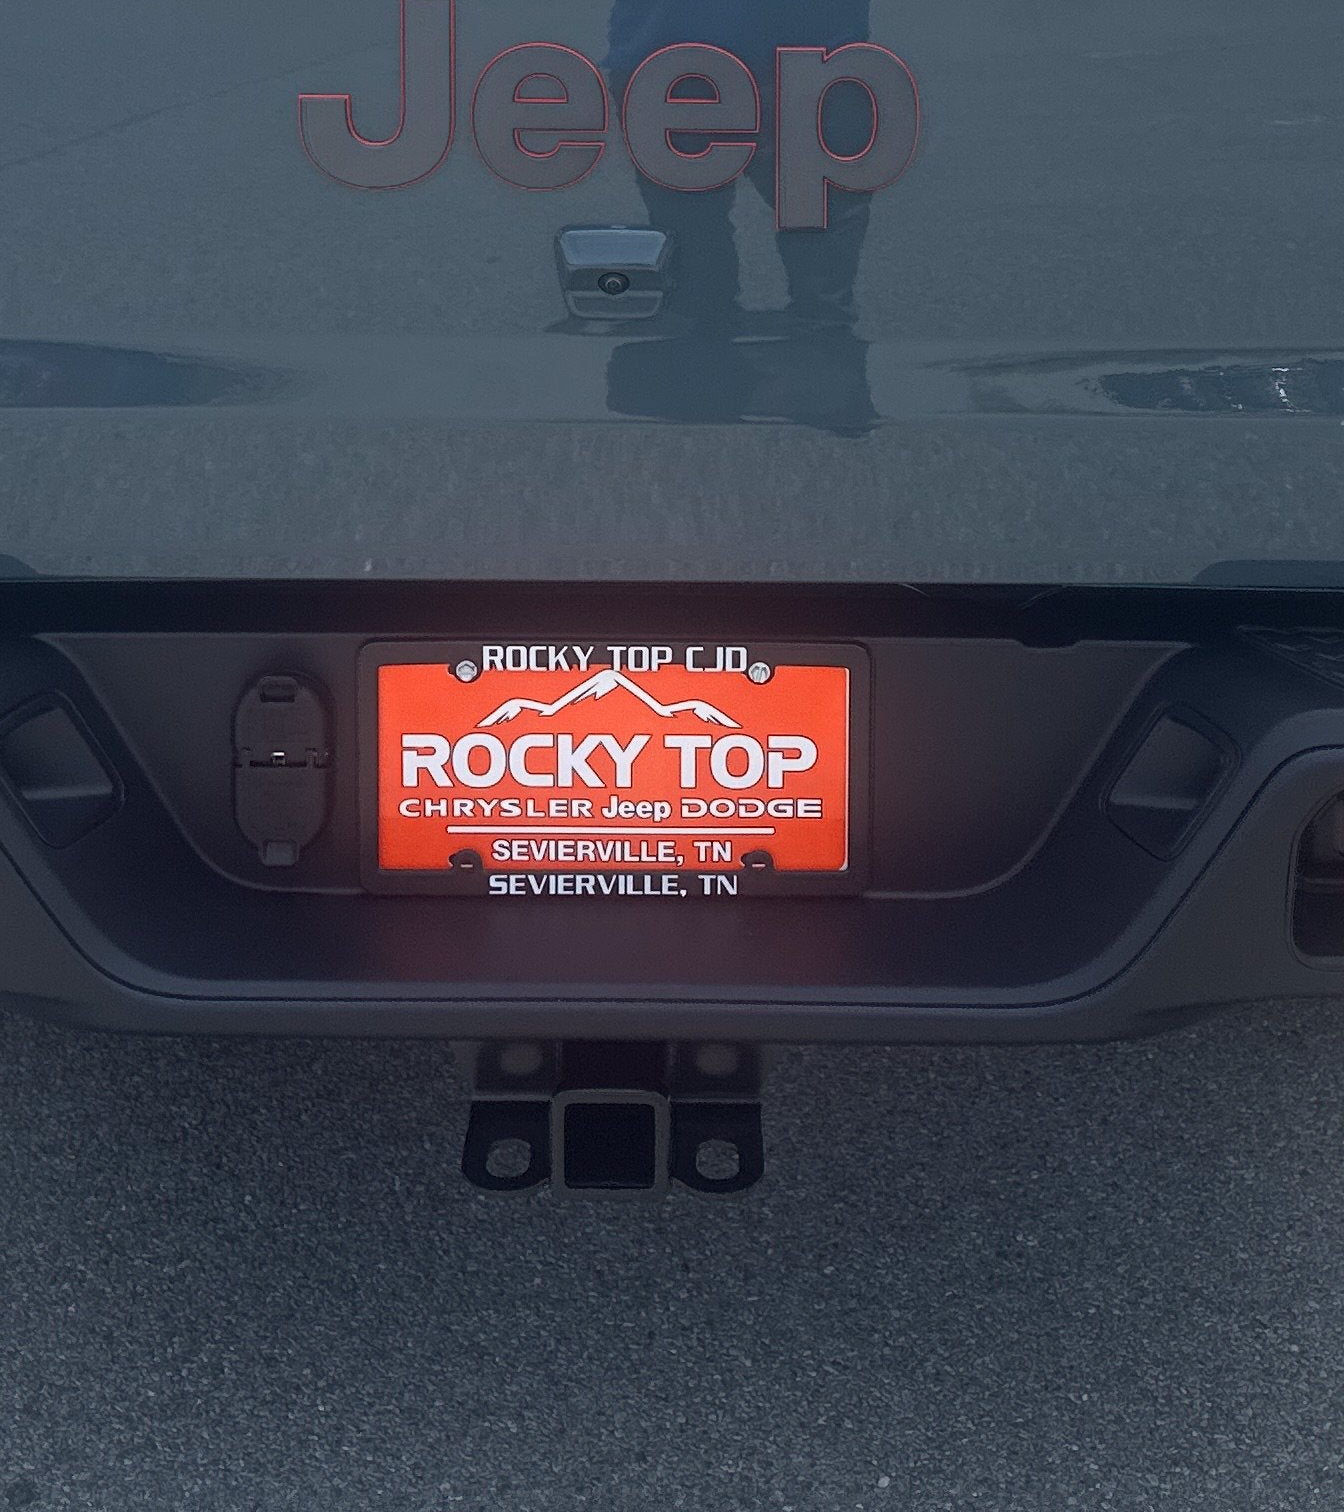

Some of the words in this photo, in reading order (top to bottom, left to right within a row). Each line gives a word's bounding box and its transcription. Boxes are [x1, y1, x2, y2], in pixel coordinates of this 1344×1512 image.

[482, 645, 595, 672] ROCKY
[606, 645, 673, 672] TOP
[685, 646, 748, 672] CJD
[401, 733, 651, 788] ROCKY
[663, 734, 818, 788] TOP
[399, 799, 593, 819] CHRYSLER
[602, 796, 672, 822] Jeep
[681, 799, 823, 819] DODGE
[492, 840, 684, 866] SEVIERVILLE,
[694, 841, 732, 862] TN
[488, 875, 688, 897] SEVIERVILLE,
[697, 875, 738, 895] TN
